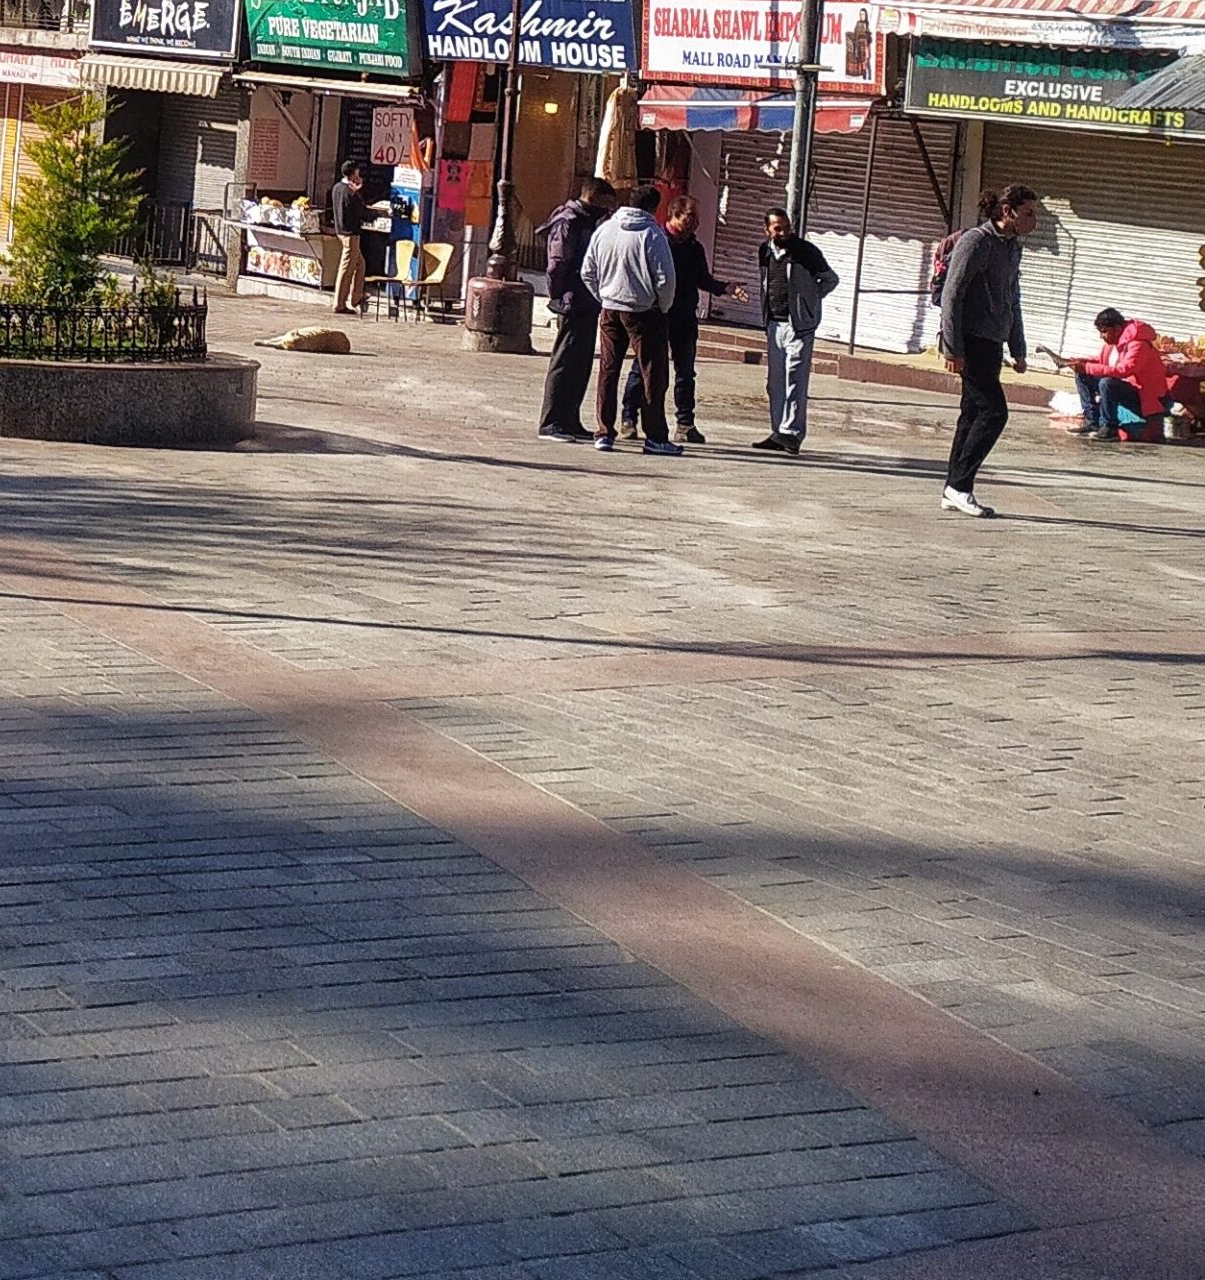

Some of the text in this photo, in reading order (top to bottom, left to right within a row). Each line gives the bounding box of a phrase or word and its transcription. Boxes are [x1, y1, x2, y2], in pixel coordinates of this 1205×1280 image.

[268, 16, 379, 44] PURE VEGETARIAN
[653, 7, 842, 45] SHARMA SHAWL EMPOUM
[384, 55, 402, 68] FOOD
[552, 41, 626, 68] HOUSE
[682, 50, 714, 67] MALL
[717, 52, 751, 69] ROAD
[1004, 79, 1102, 102] EXCLUSIVE
[374, 112, 412, 128] SOFTY
[928, 92, 1185, 128] HANDLOOMS AND HANDICRAFTS
[374, 146, 410, 163] 40/-
